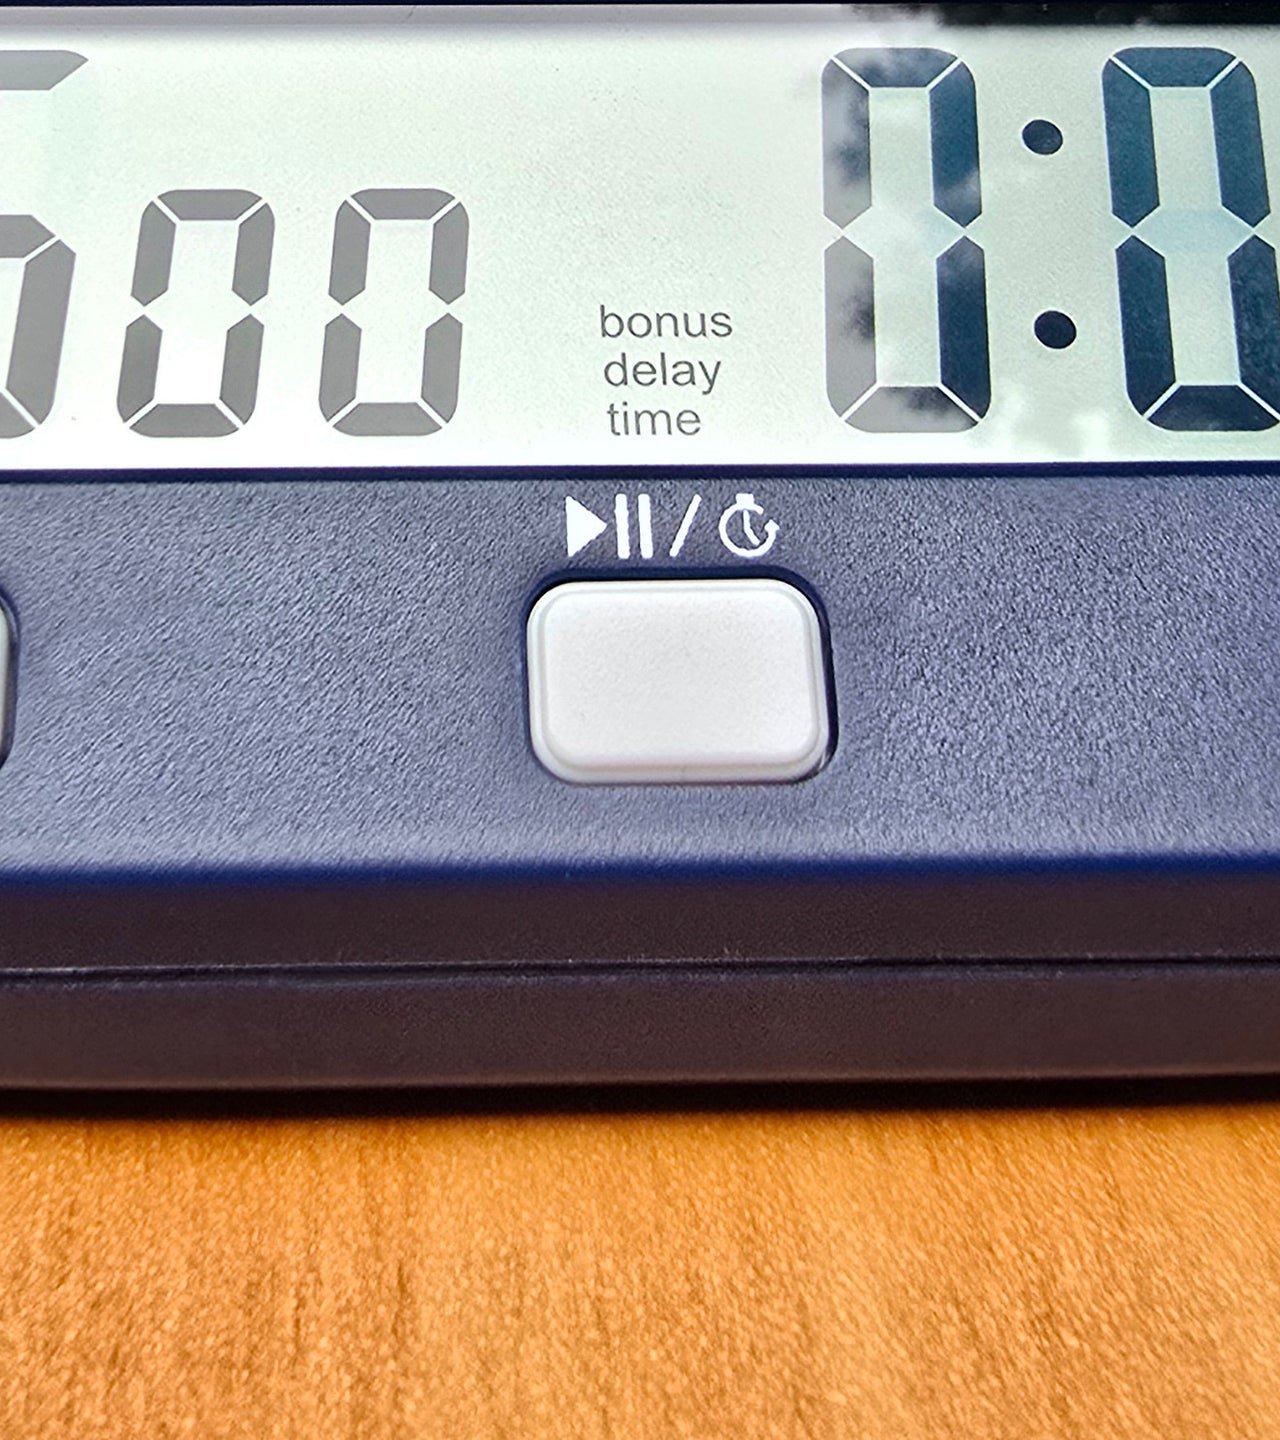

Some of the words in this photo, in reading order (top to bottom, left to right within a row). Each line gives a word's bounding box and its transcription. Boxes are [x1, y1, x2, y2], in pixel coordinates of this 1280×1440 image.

[600, 304, 733, 338] bonus
[604, 352, 721, 395] delay
[607, 401, 701, 436] time
